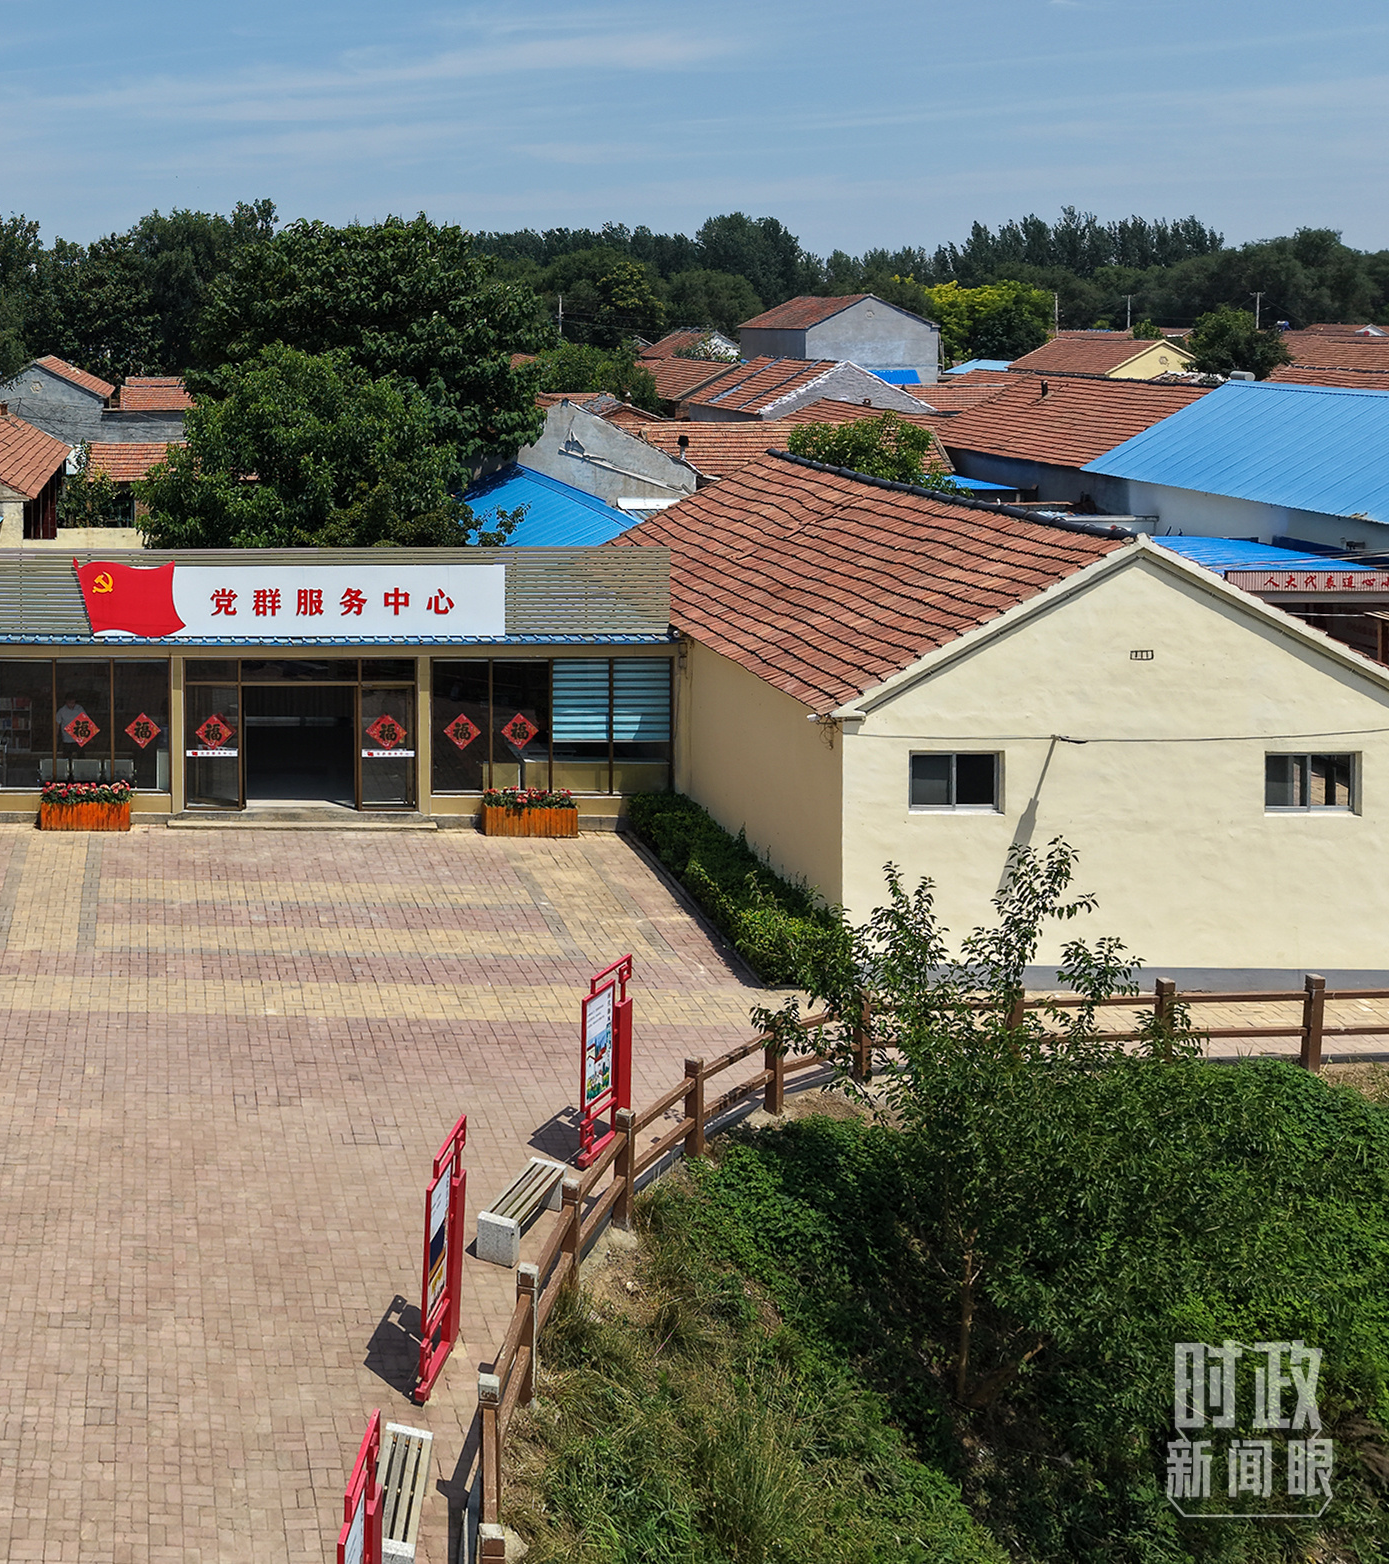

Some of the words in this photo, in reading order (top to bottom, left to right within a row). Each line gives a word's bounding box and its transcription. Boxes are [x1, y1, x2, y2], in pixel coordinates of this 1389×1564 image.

[210, 587, 455, 616] 党群服务中心
